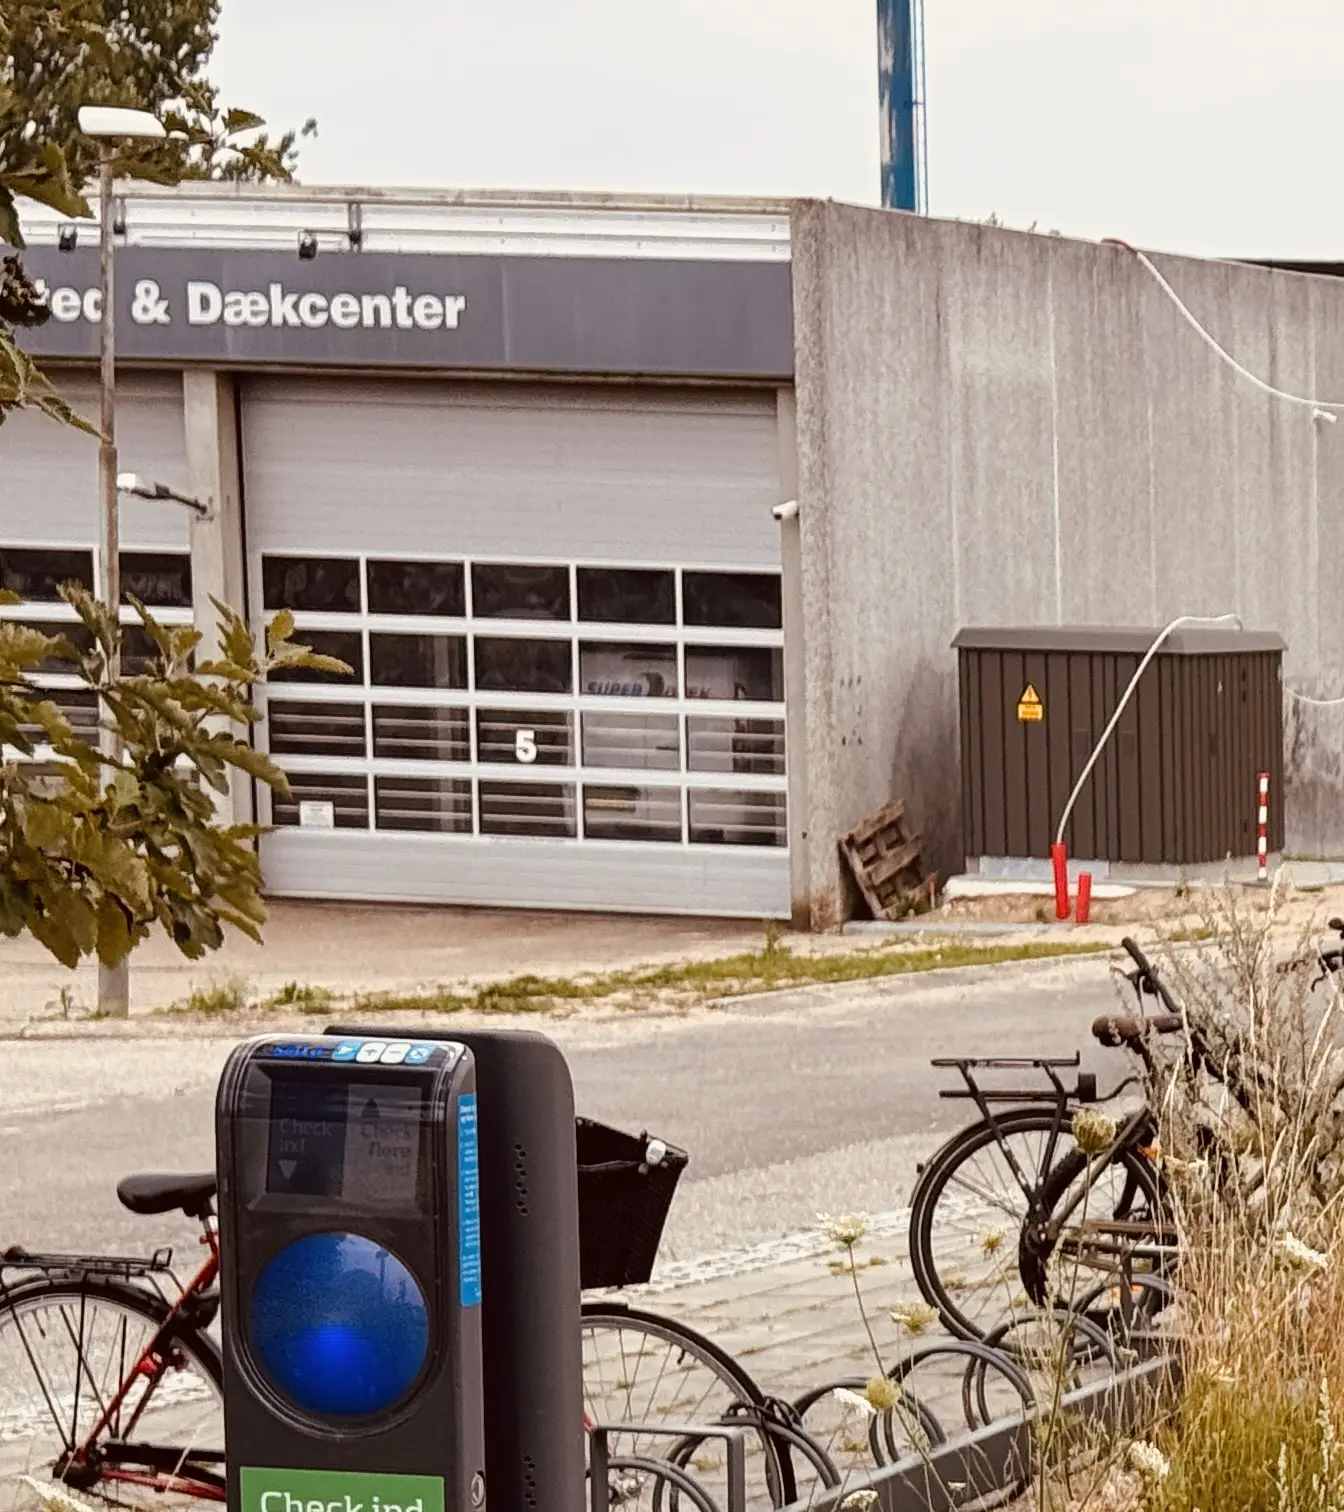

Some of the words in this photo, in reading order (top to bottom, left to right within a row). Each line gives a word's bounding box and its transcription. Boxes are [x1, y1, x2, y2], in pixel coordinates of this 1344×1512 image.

[131, 279, 171, 324] &
[187, 281, 467, 329] Dækcenter
[515, 729, 538, 763] 5
[279, 1118, 333, 1138] Check
